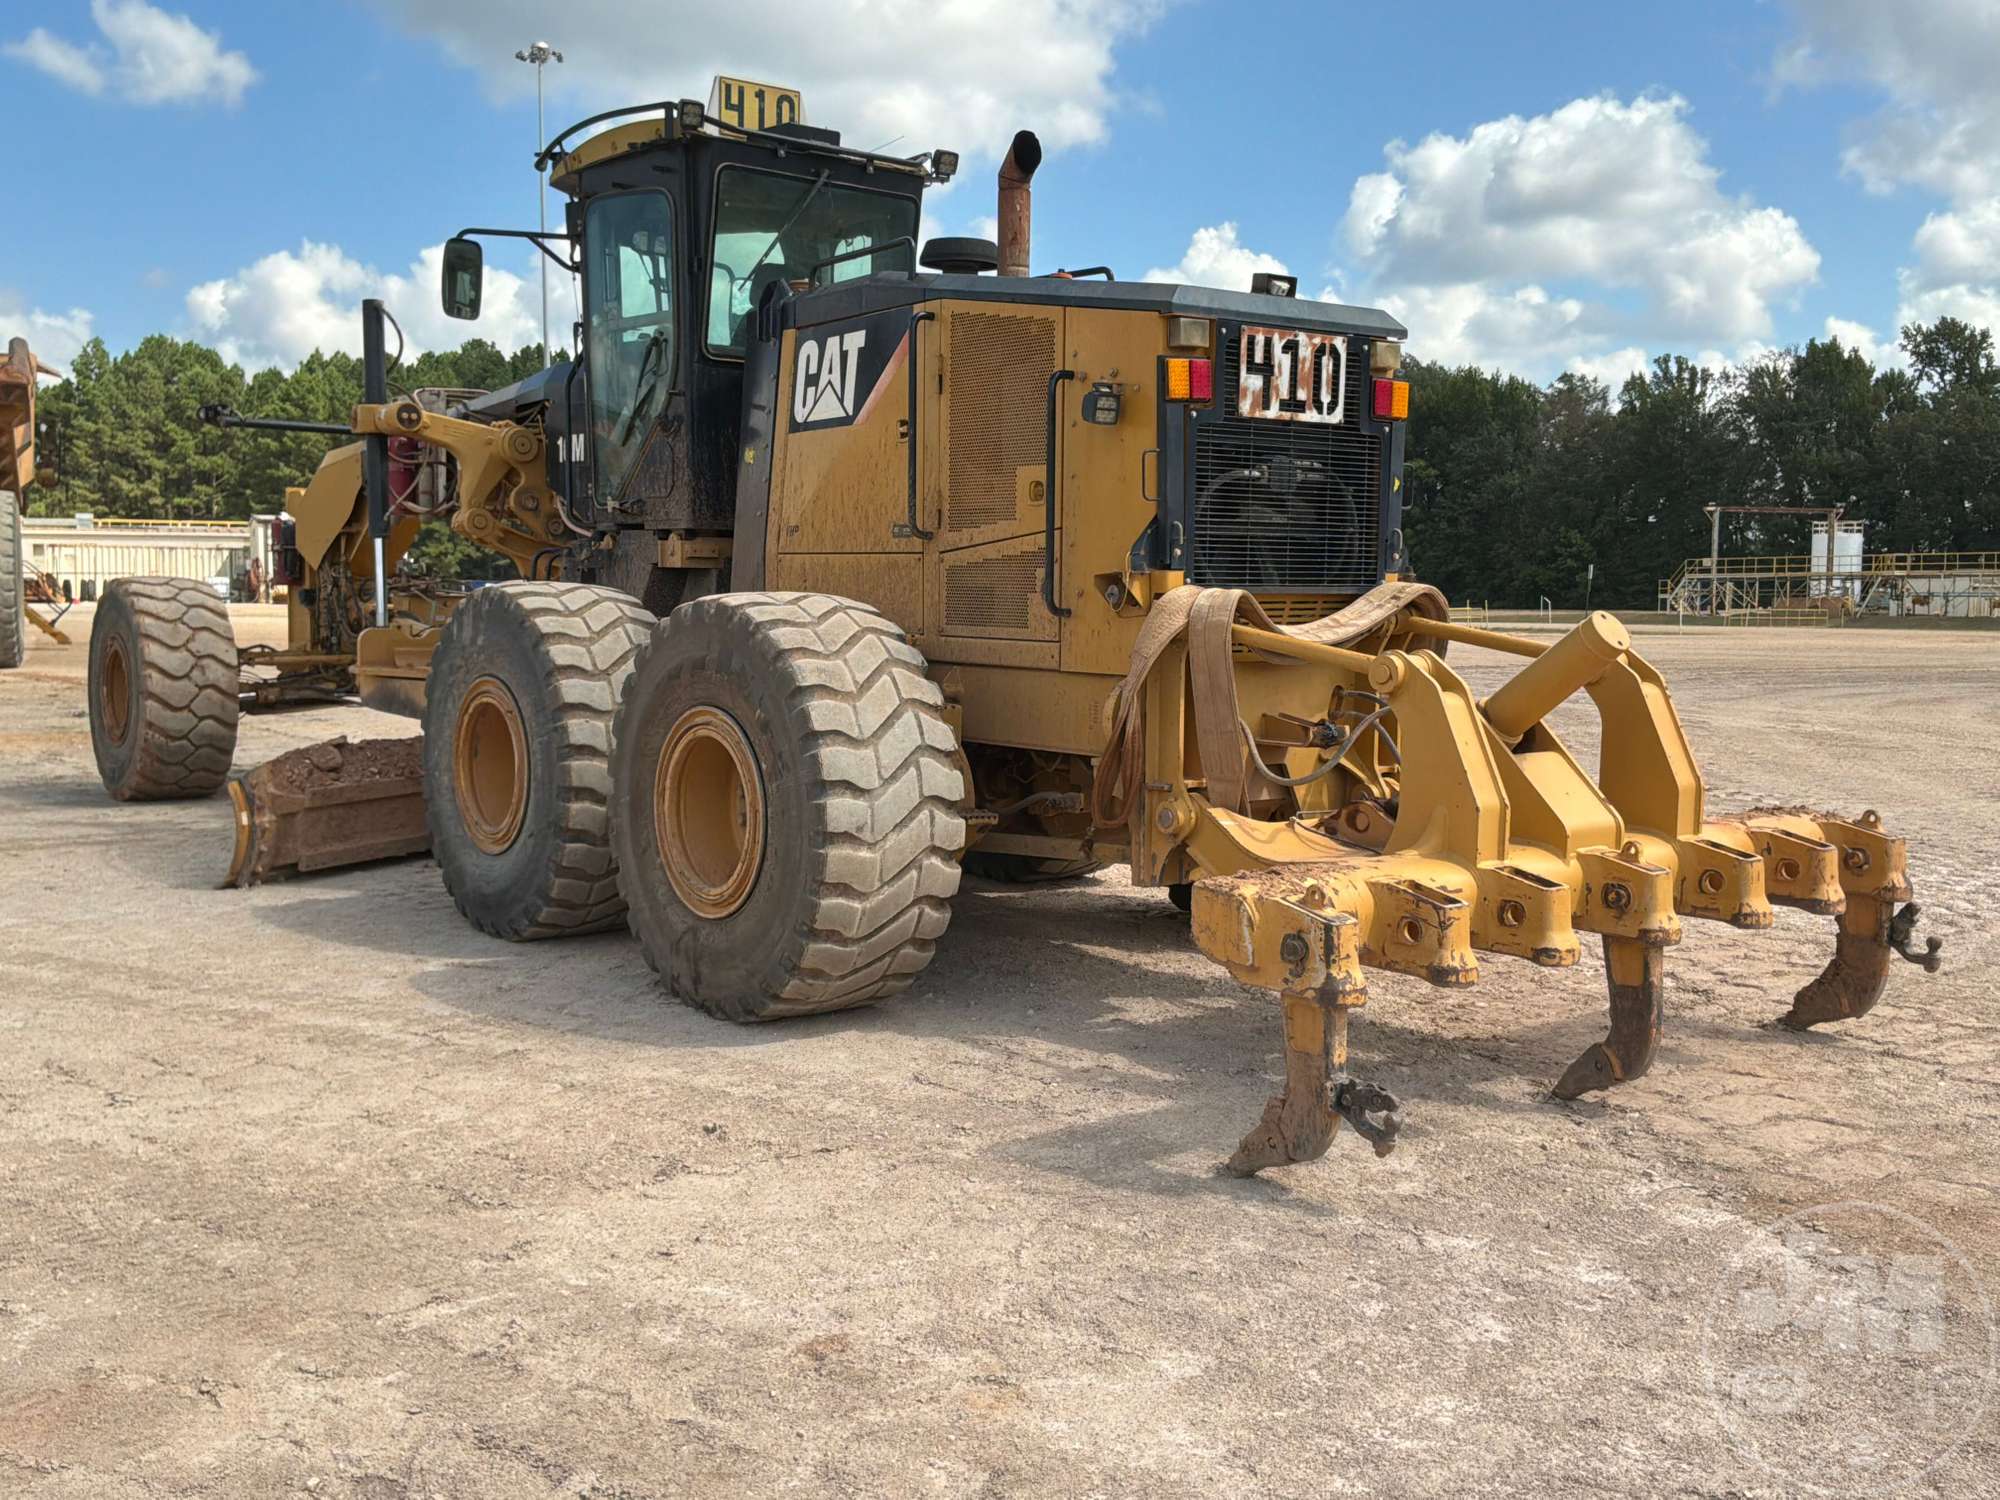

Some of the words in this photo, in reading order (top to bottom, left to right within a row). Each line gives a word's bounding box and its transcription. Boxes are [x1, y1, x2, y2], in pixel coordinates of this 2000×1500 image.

[724, 83, 796, 130] 410
[794, 329, 866, 423] CAT
[1245, 333, 1342, 416] 410
